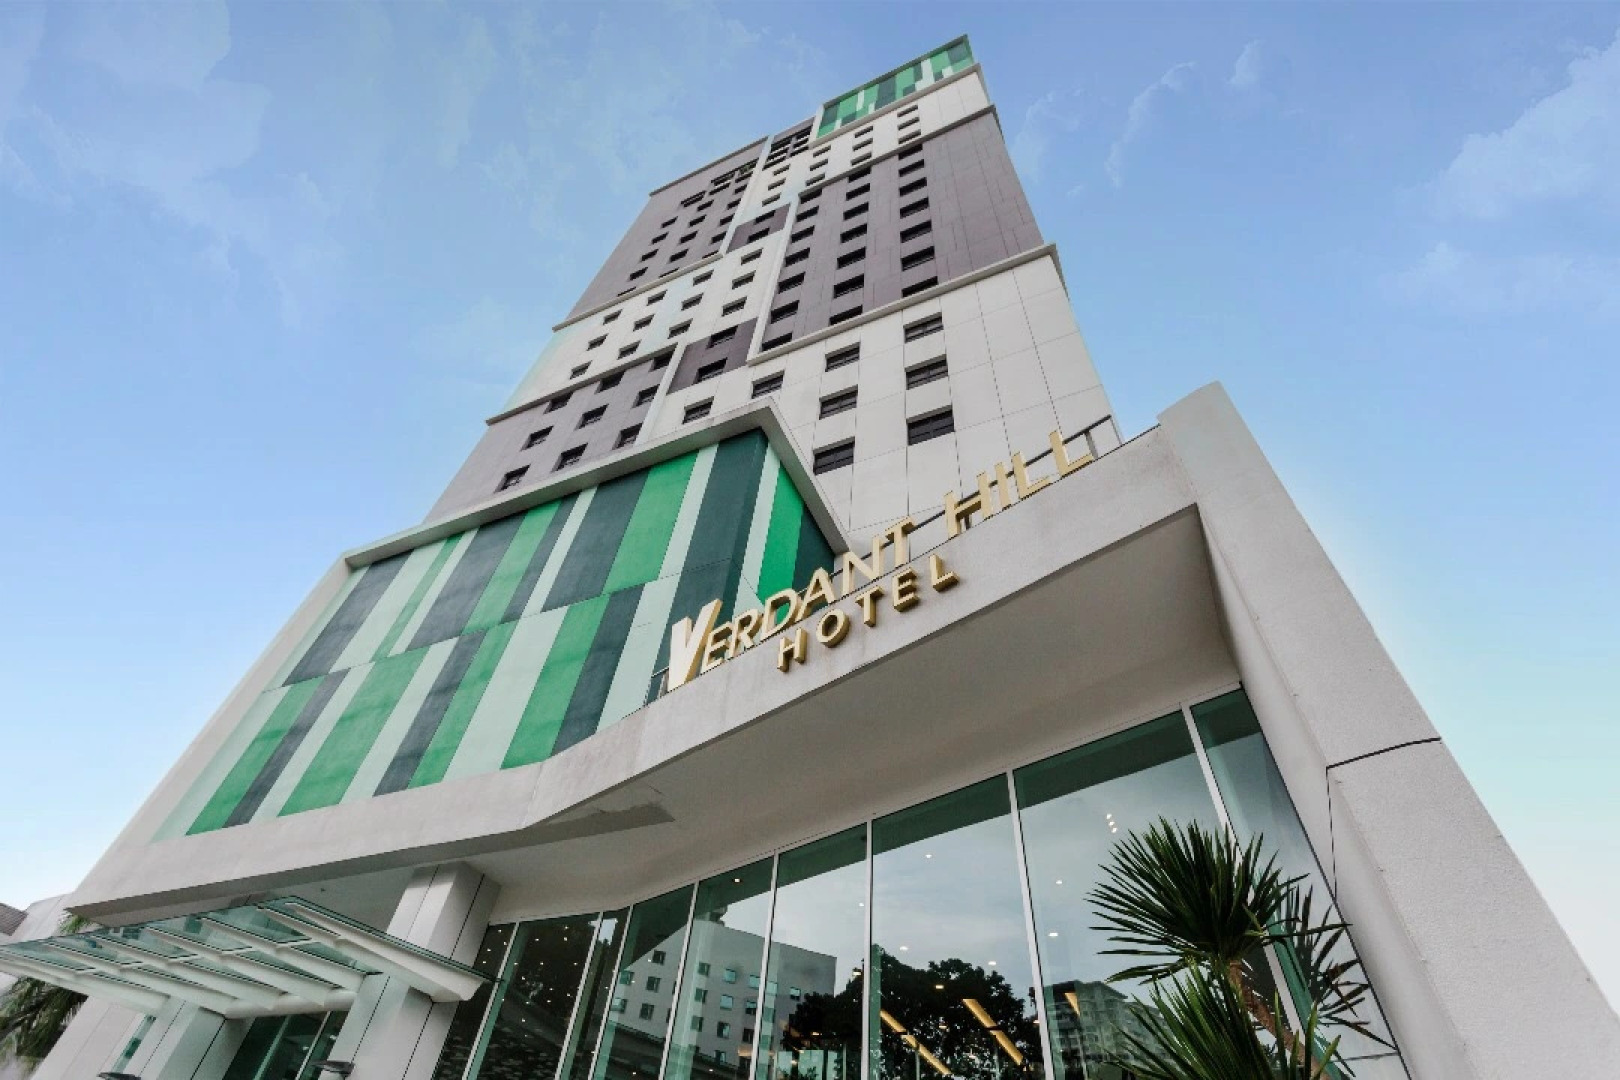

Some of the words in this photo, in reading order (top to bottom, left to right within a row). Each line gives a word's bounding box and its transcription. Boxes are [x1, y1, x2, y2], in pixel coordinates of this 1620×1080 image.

[667, 517, 915, 691] VERDANT
[944, 430, 1095, 539] HILL
[777, 554, 960, 672] HOTEL
